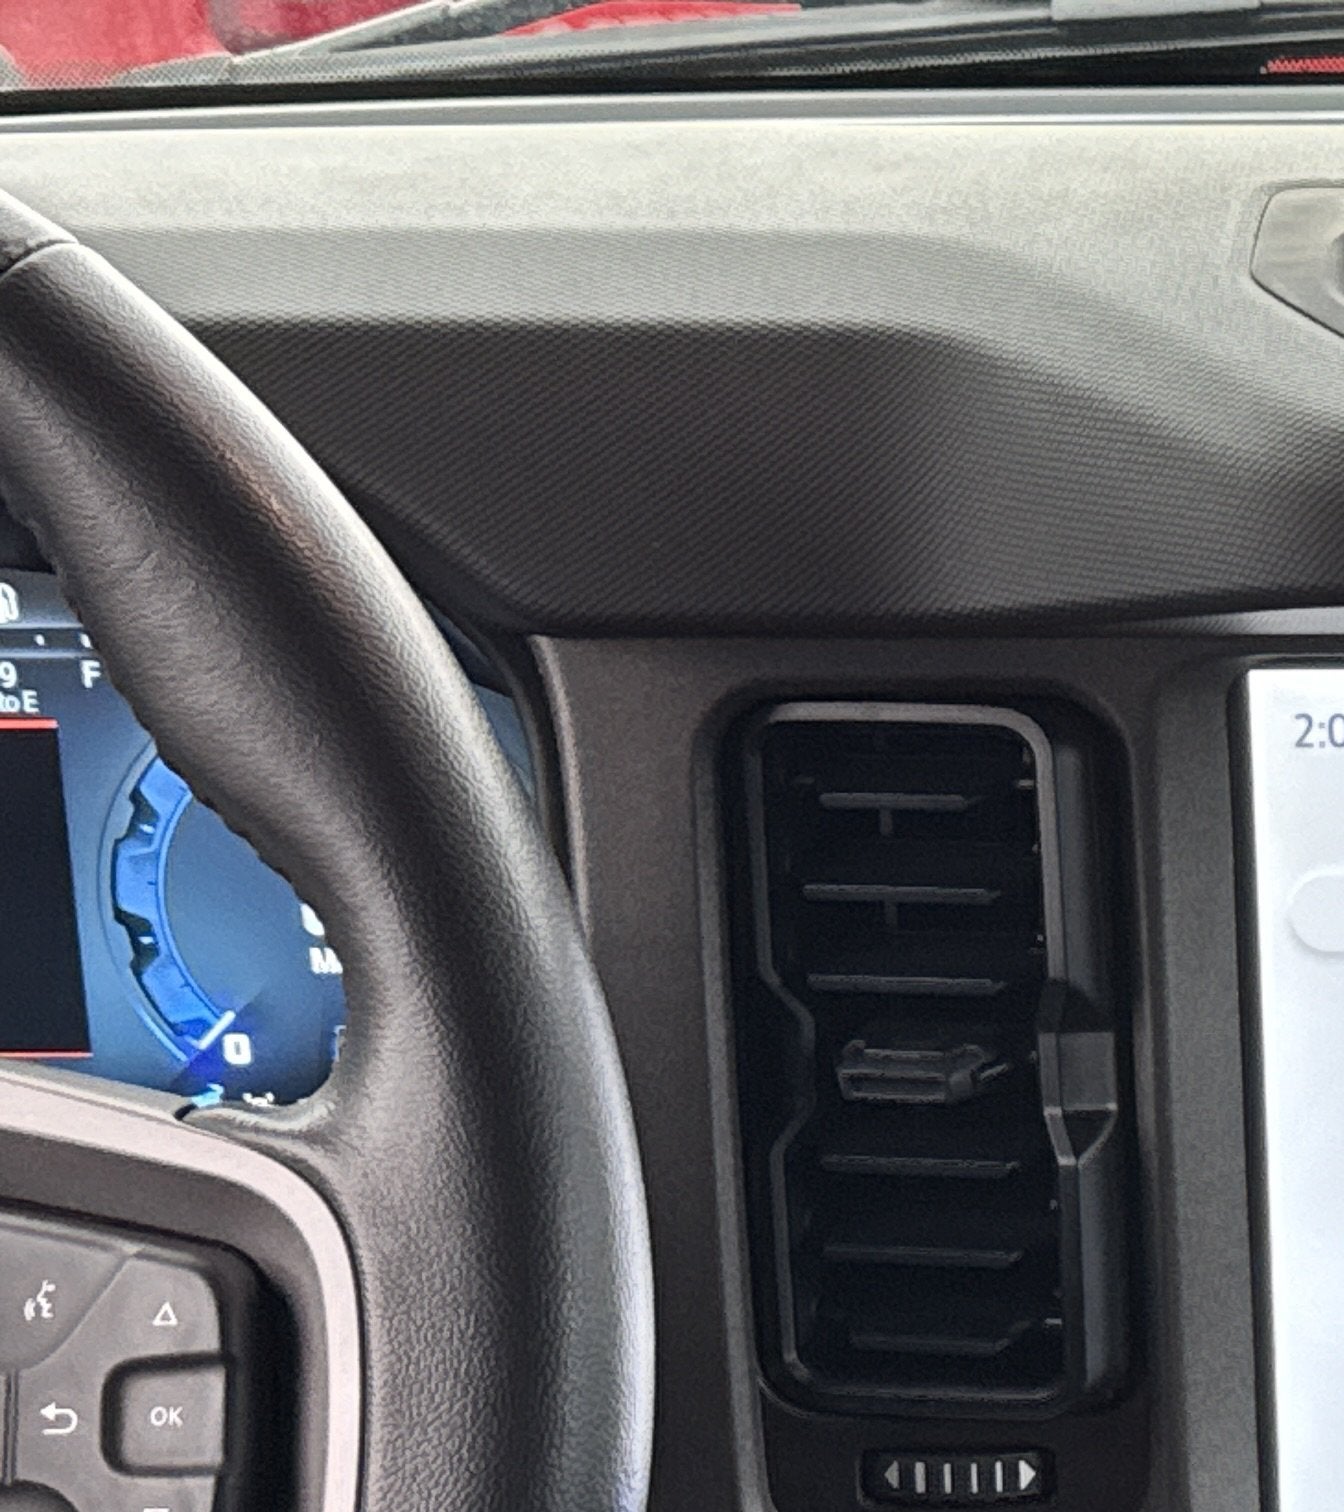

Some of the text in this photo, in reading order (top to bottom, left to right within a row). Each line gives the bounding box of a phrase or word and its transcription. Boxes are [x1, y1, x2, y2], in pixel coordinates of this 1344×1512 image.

[81, 660, 100, 688] F
[222, 1033, 252, 1066] 0
[150, 1406, 183, 1428] OK
